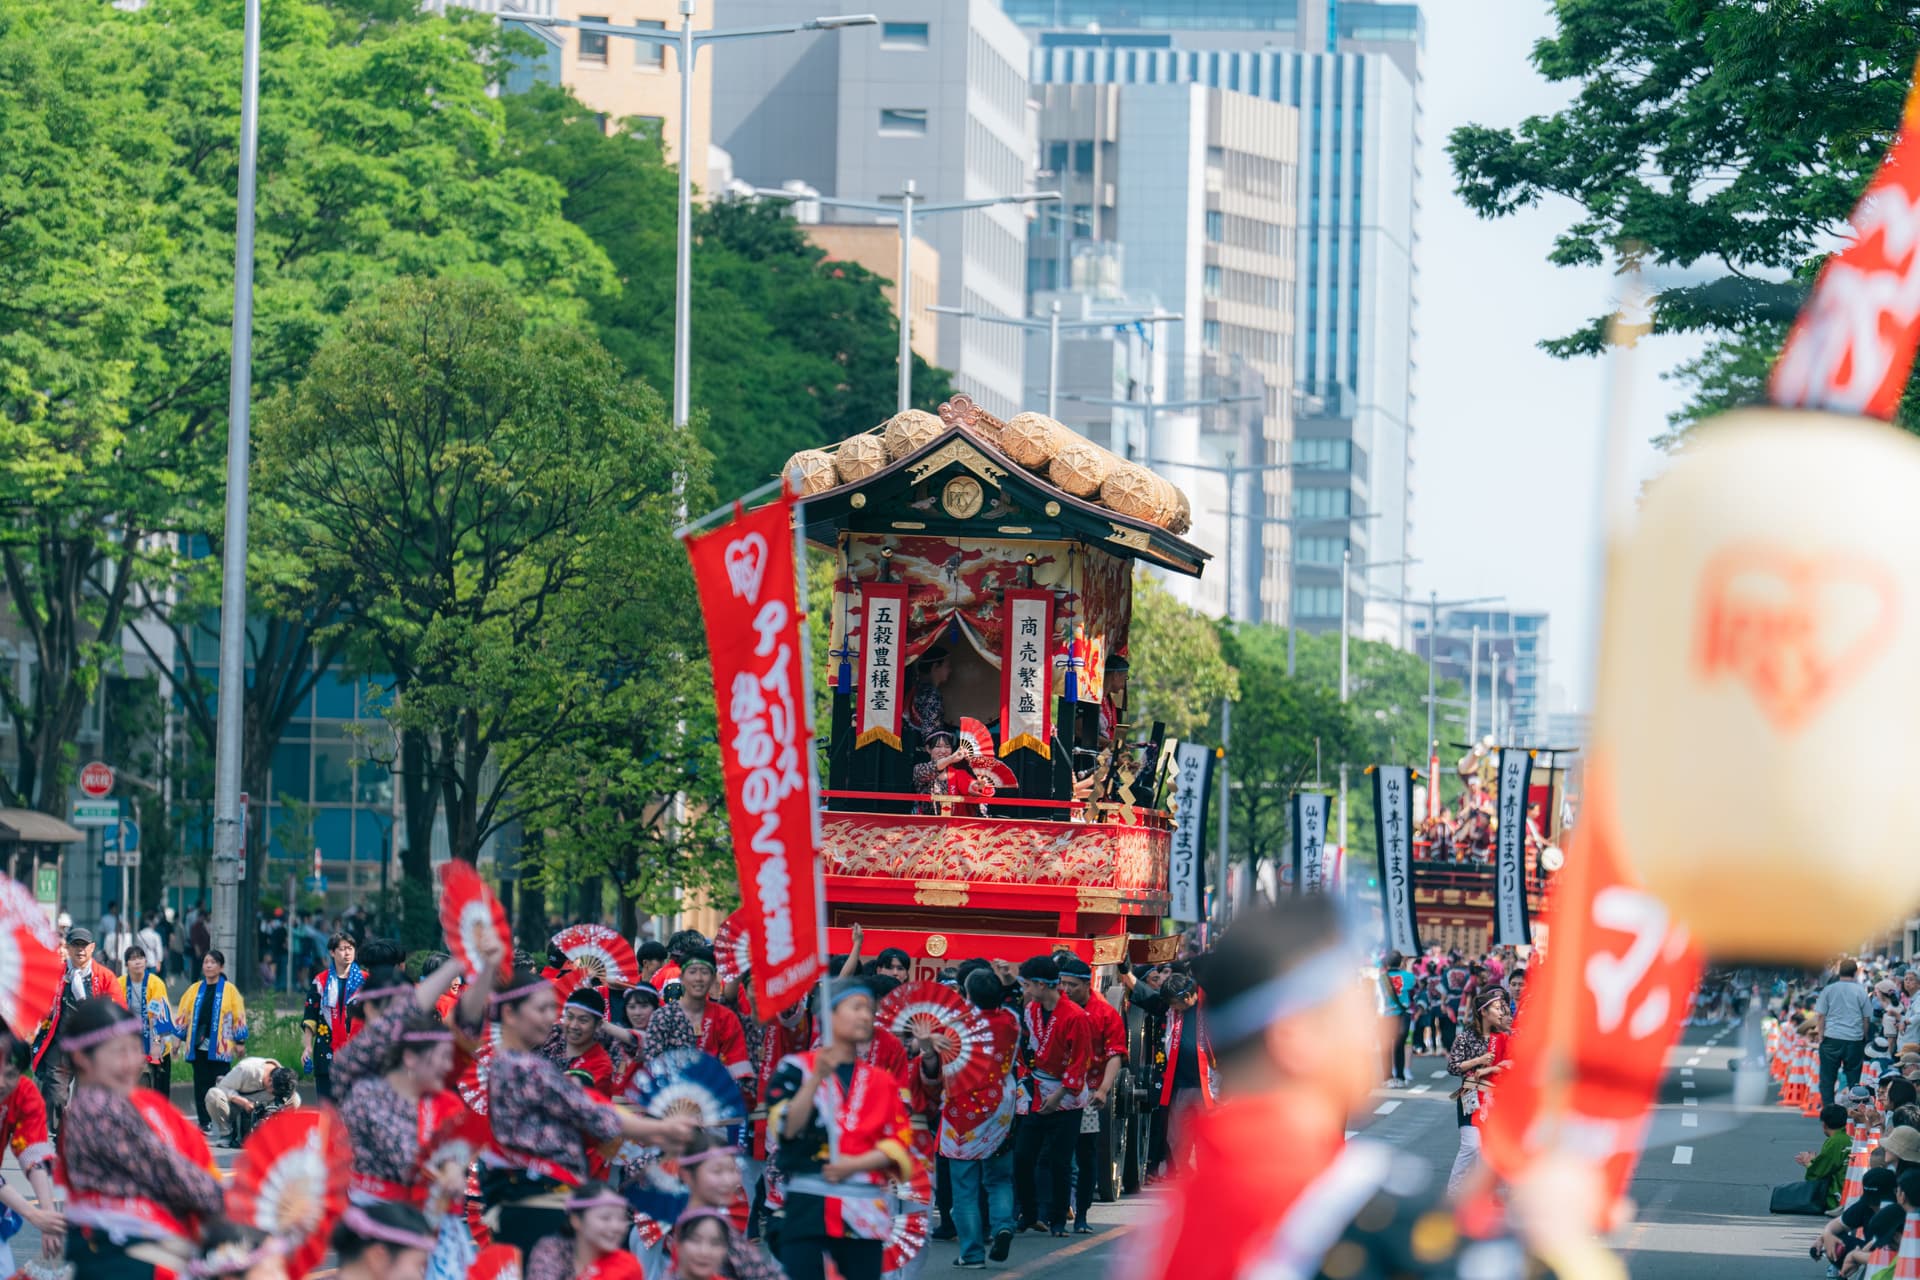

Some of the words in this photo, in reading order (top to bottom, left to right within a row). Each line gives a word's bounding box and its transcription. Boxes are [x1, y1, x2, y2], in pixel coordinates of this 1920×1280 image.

[752, 599, 804, 799] アイリス
[1017, 616, 1038, 713] 商売繁盛
[1386, 779, 1405, 906] 仙台青葉まつり
[1503, 762, 1520, 894] 仙台青葉まつり
